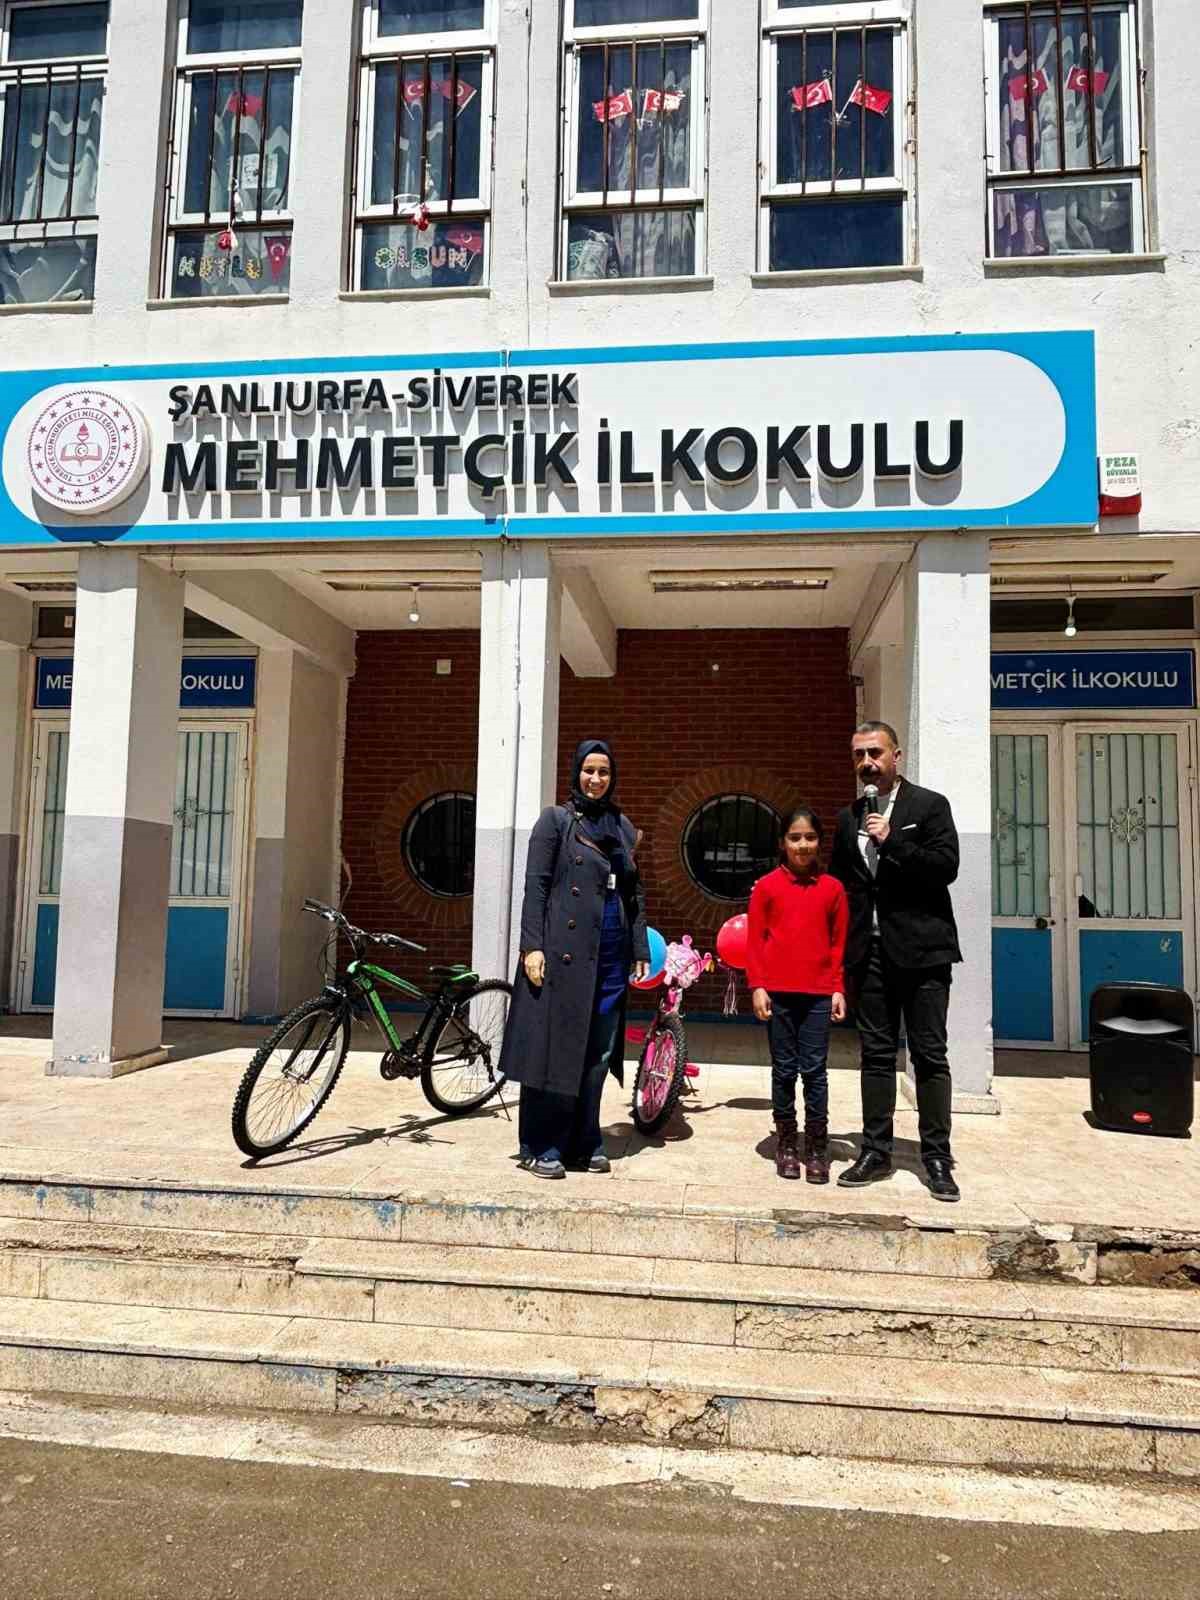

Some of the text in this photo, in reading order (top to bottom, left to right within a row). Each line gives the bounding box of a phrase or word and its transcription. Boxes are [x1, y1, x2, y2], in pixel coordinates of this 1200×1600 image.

[167, 367, 577, 420] ŞANLIURFA-SİVEREK
[162, 417, 963, 497] MEHMETÇİK İLKOKULU
[1105, 456, 1137, 467] FEZA
[1072, 667, 1178, 689] İLKOKULU
